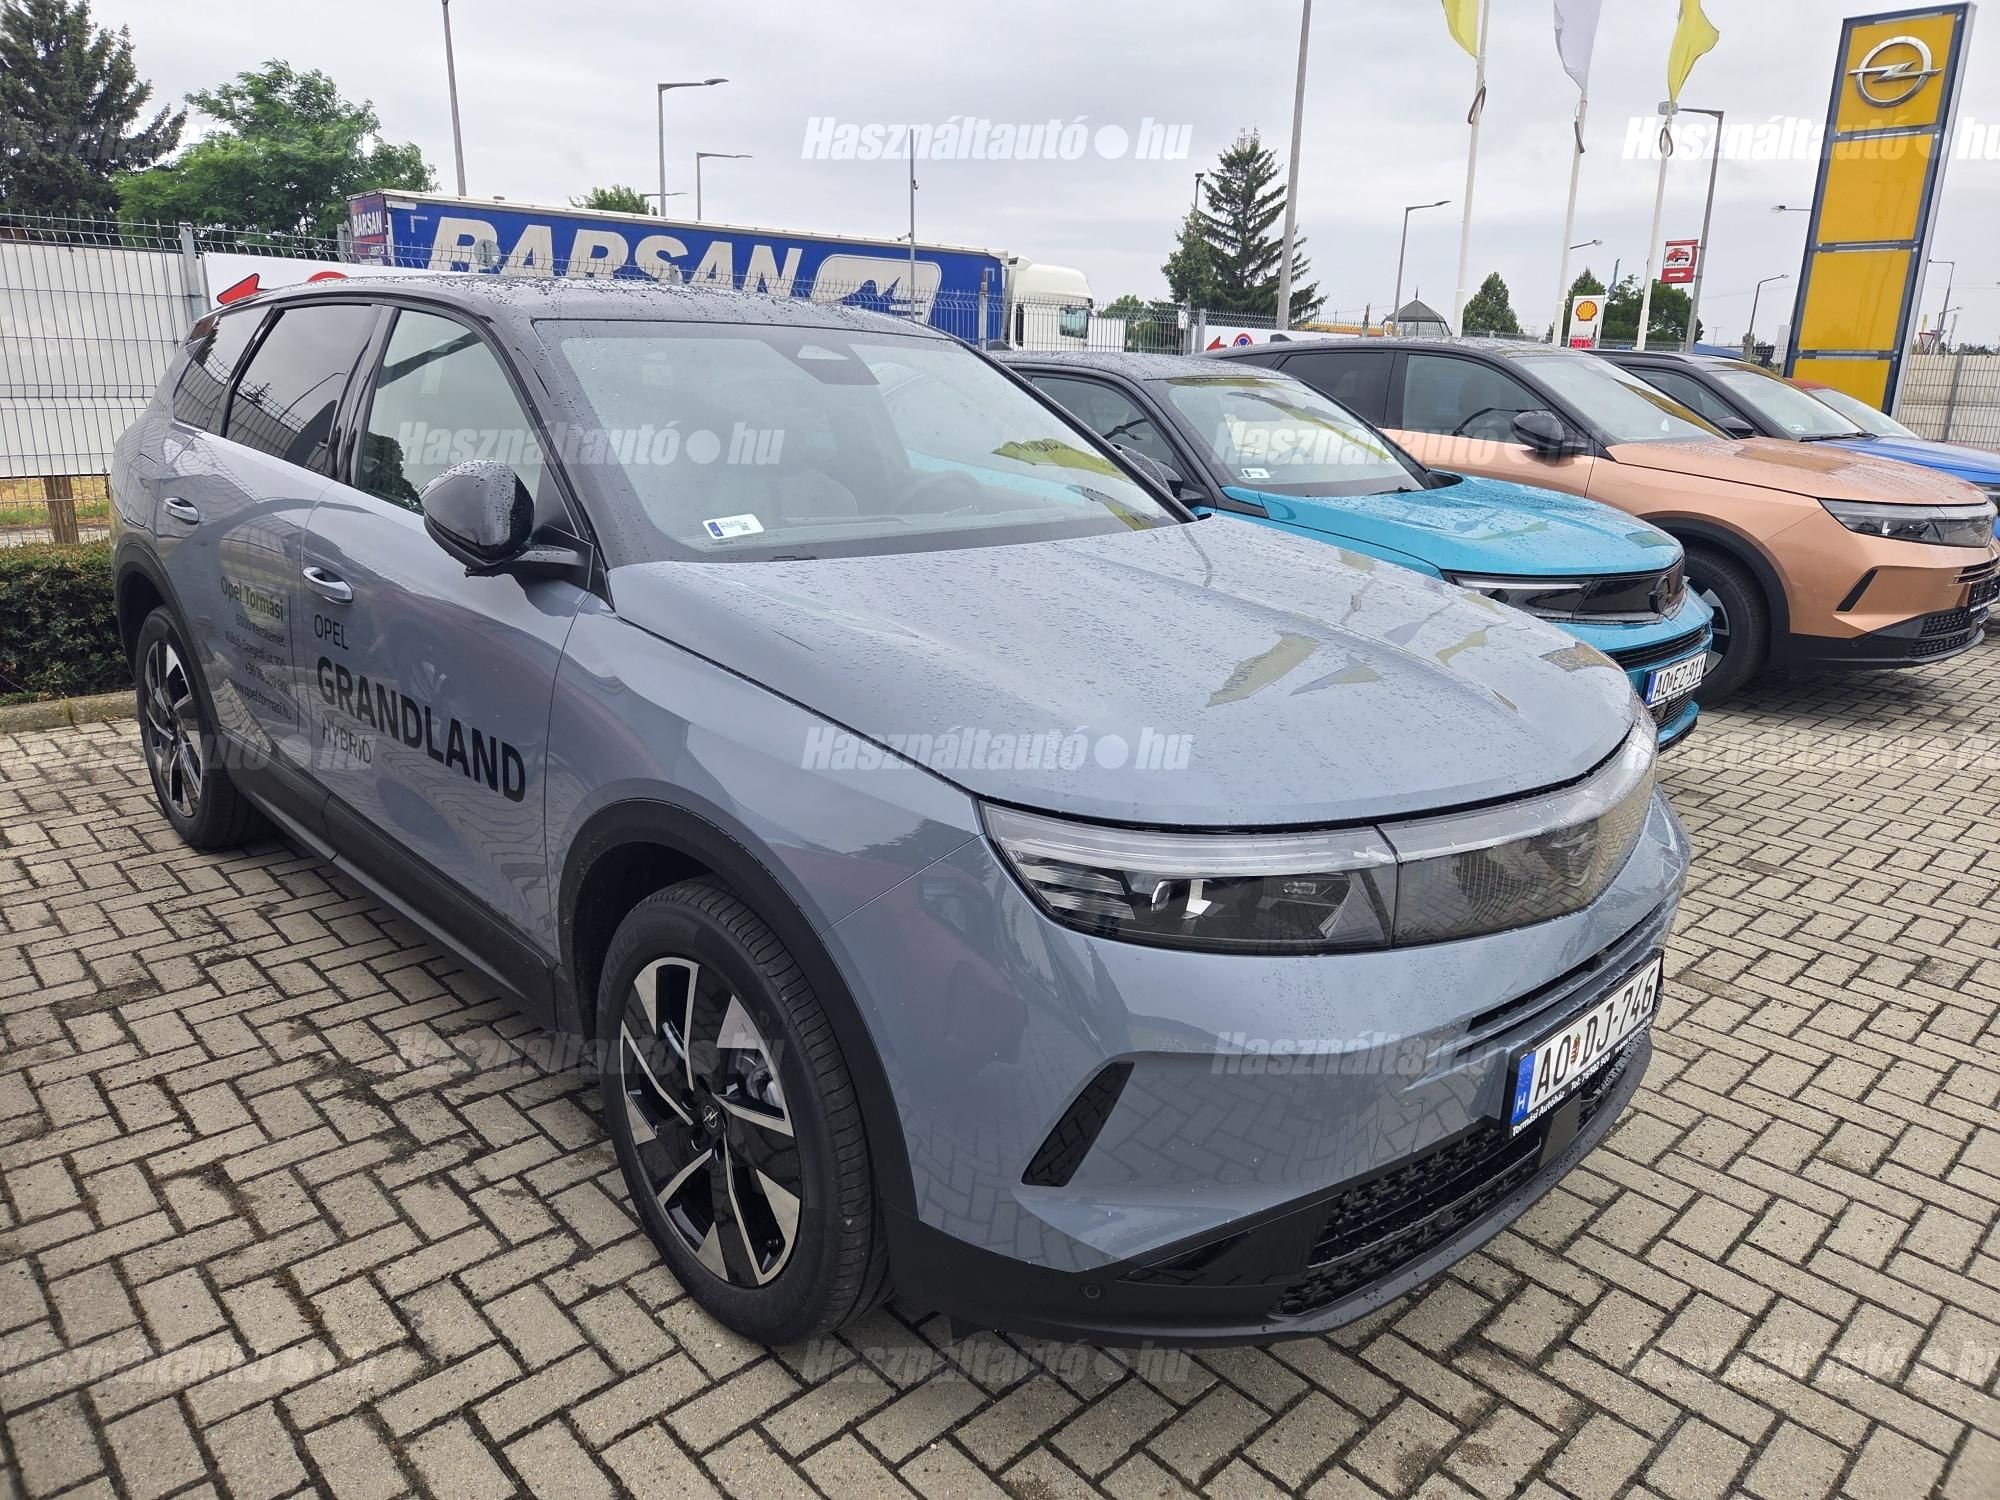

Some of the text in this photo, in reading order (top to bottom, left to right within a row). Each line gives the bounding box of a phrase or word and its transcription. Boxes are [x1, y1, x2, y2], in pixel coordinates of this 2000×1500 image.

[353, 211, 382, 236] BARSAN
[221, 576, 284, 621] Opel Tormási
[314, 614, 349, 650] OPEL
[316, 656, 527, 803] GRANDLAND
[322, 717, 372, 764] HYBRID
[1516, 1091, 1526, 1113] H
[1512, 1110, 1539, 1136] Tormási
